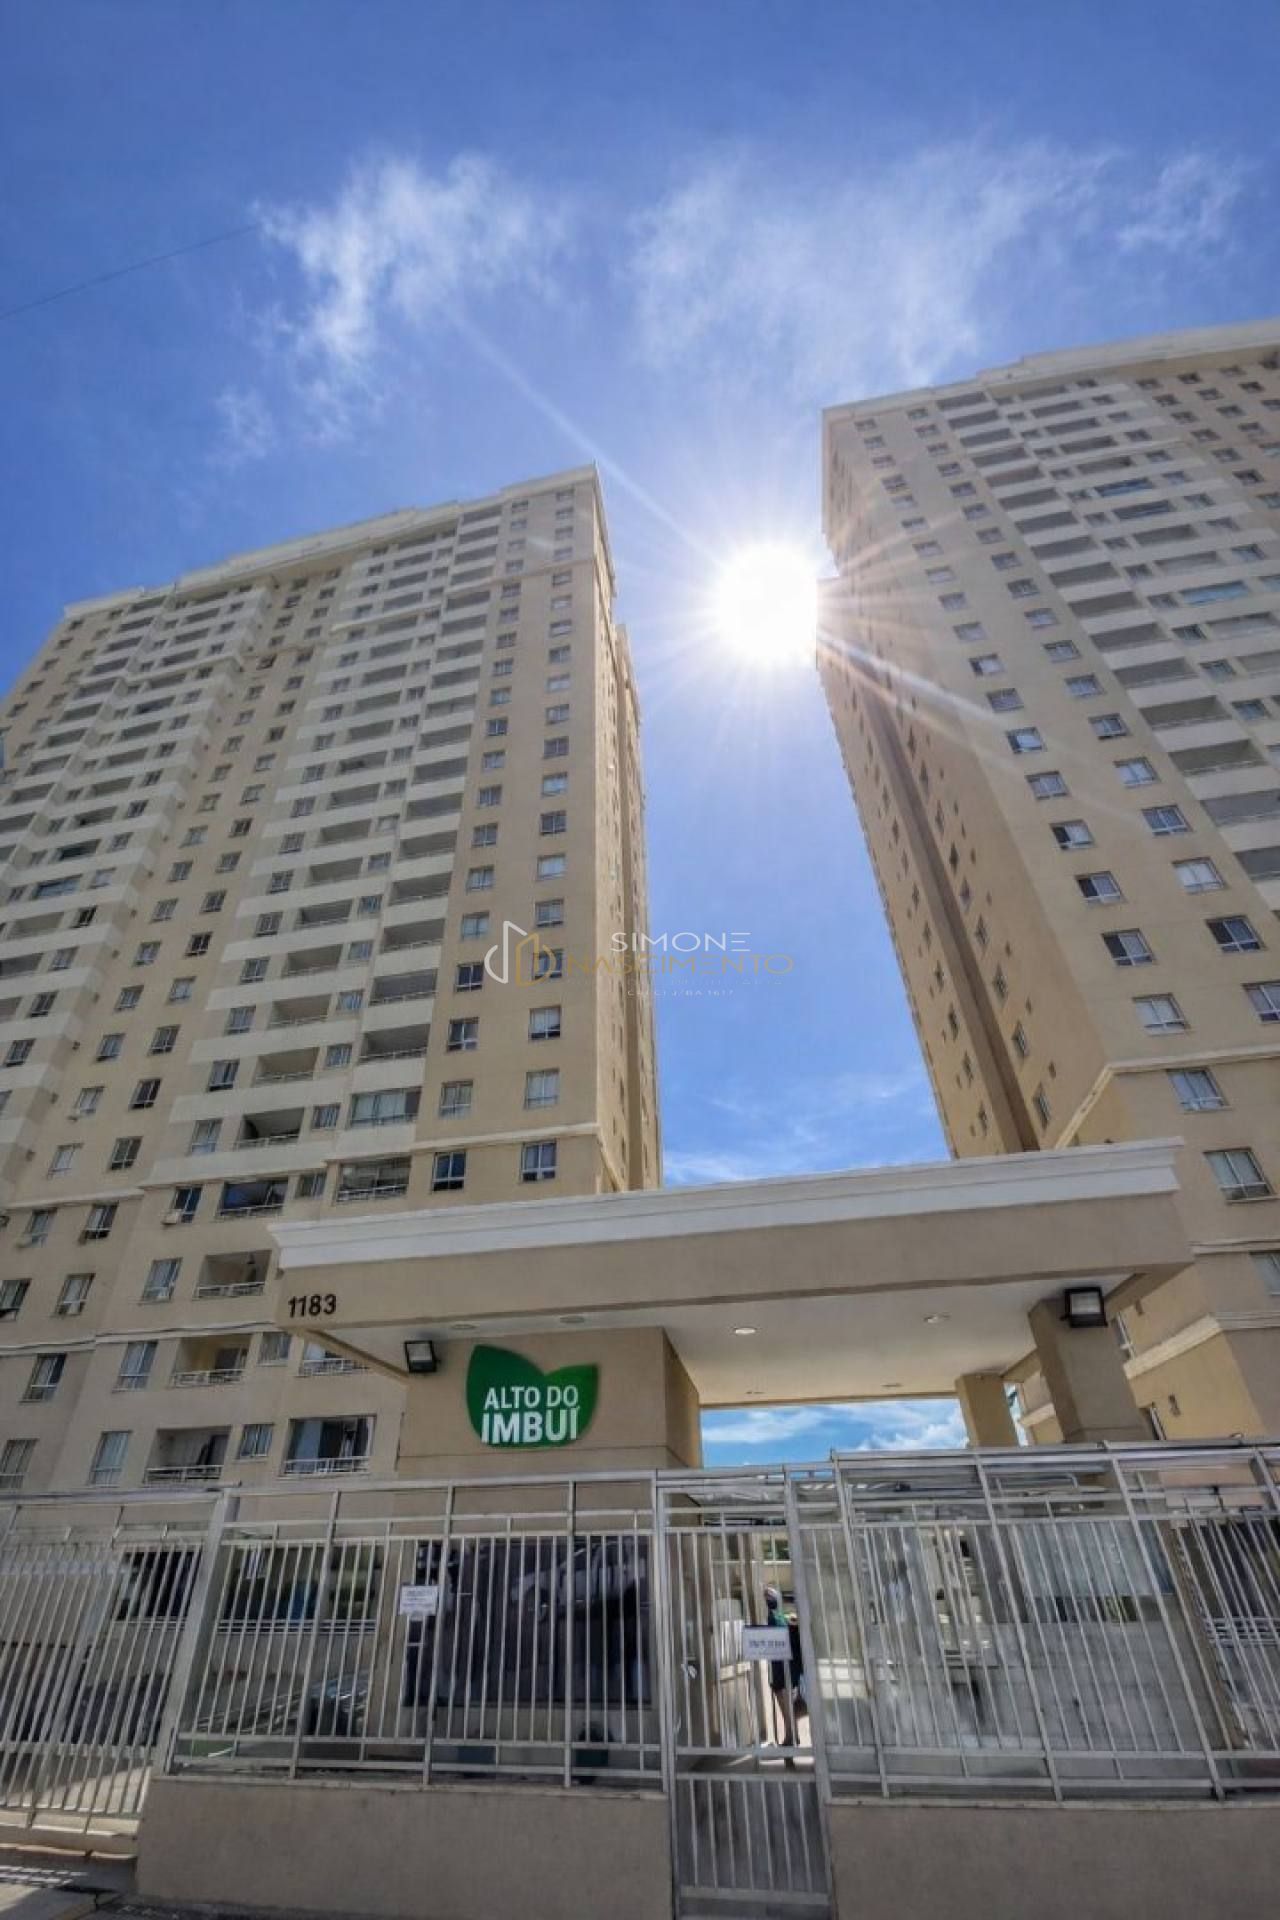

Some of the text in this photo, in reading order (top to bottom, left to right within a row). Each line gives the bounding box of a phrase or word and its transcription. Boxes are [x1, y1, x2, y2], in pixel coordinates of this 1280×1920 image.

[288, 1294, 336, 1317] 1183
[484, 1385, 579, 1410] ALTO DO
[481, 1404, 581, 1444] IMBUÍ
